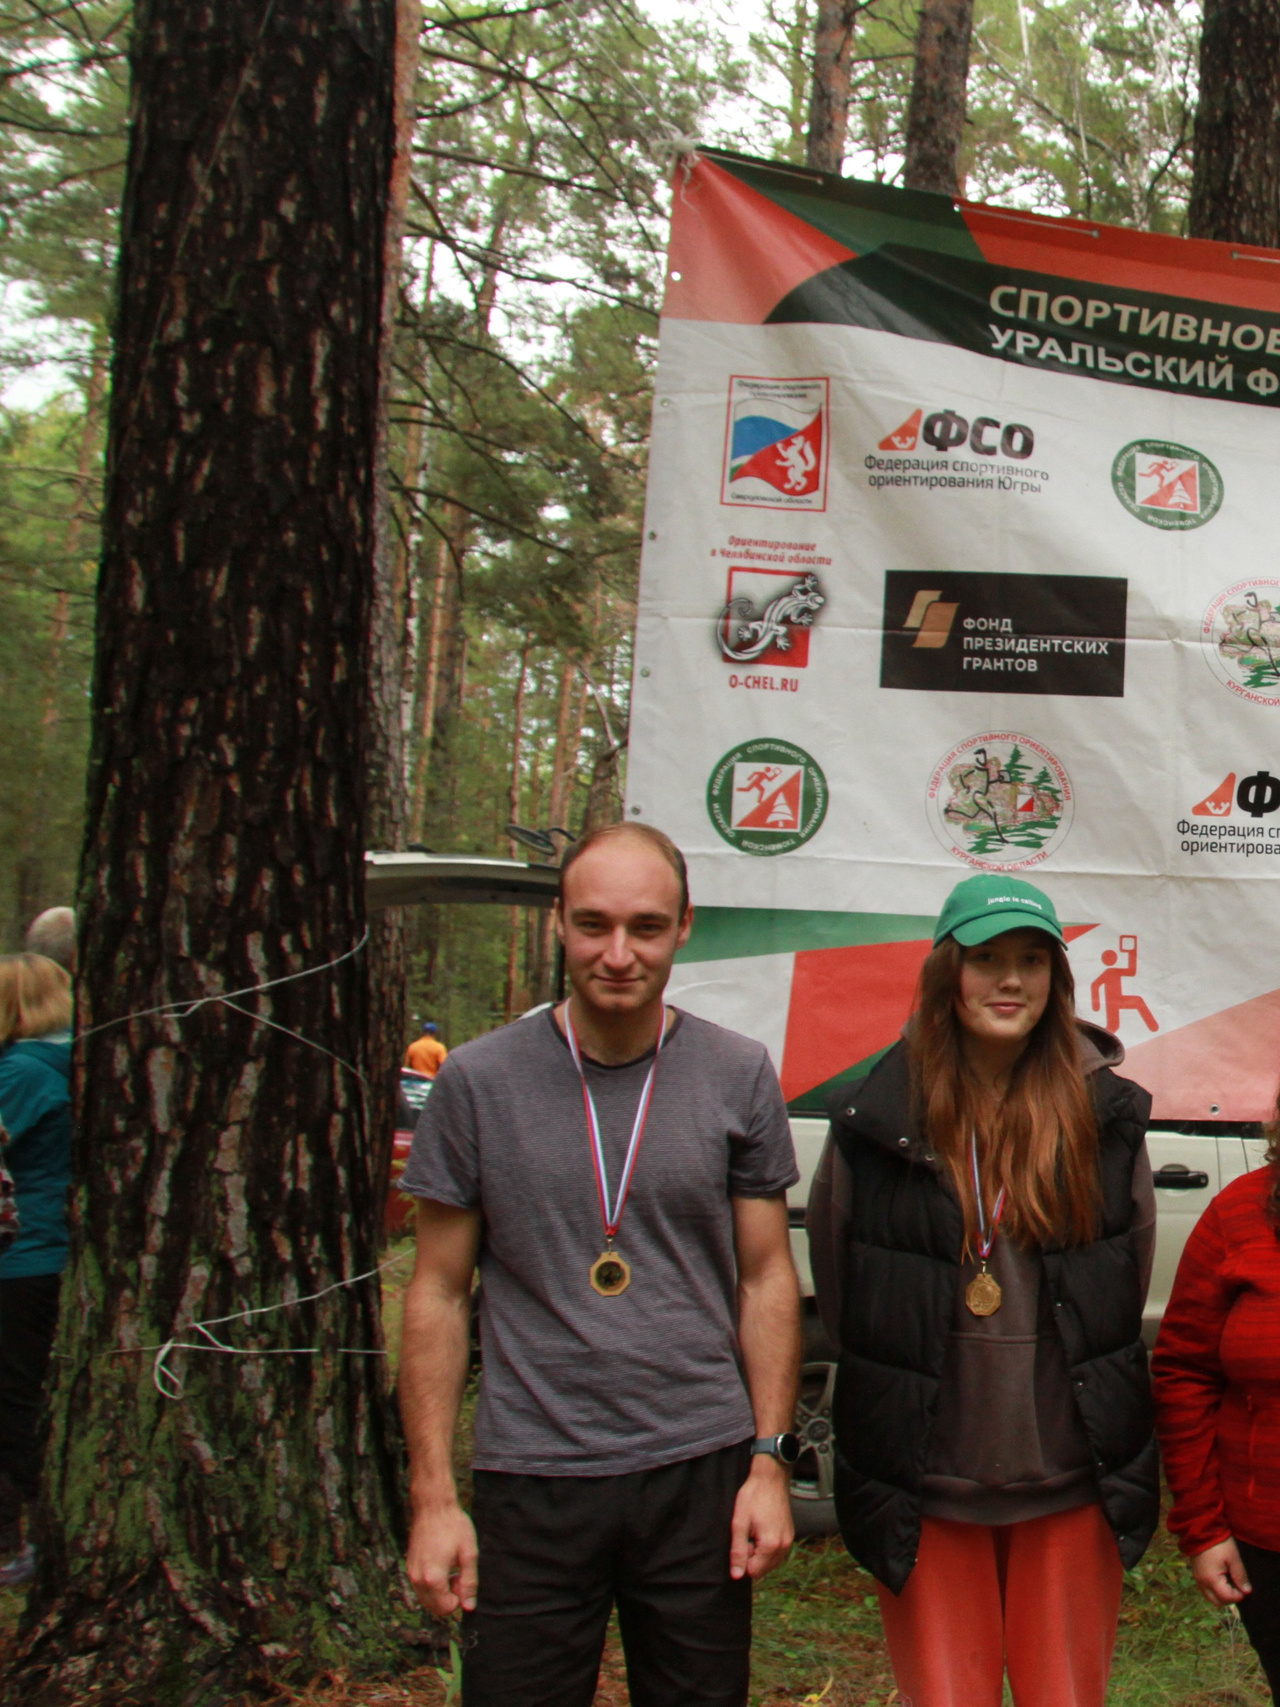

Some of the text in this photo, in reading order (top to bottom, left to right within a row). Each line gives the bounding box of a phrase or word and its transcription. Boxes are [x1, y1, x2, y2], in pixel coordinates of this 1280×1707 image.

[988, 323, 1234, 392] УРАЛЬСКИЙ
[922, 408, 1035, 460] ФСО
[864, 454, 1050, 481] Федерация спортивного
[868, 474, 1042, 494] ориентирования Югры
[728, 535, 817, 551] Ориентирование
[719, 548, 785, 563] Челябинской
[787, 553, 832, 566] области
[962, 617, 1012, 633] ФОНД
[963, 637, 1109, 655] ПРЕЗИДЕНТСКИХ
[962, 657, 1038, 672] ГРАНТОВ
[729, 674, 799, 692] O-CHEL.RU
[1226, 679, 1280, 706] КУРГАНСКОЙ
[746, 743, 806, 763] СПОРТИВНОГО
[929, 733, 1071, 801] ФЕДЕРАЦИЯ СПОРТИВНОГО ОРИЕНТИРОВАНИЯ
[1177, 819, 1264, 840] Федерация
[951, 846, 1048, 872] КУРГАНСКОЙ ОБЛАСТИ
